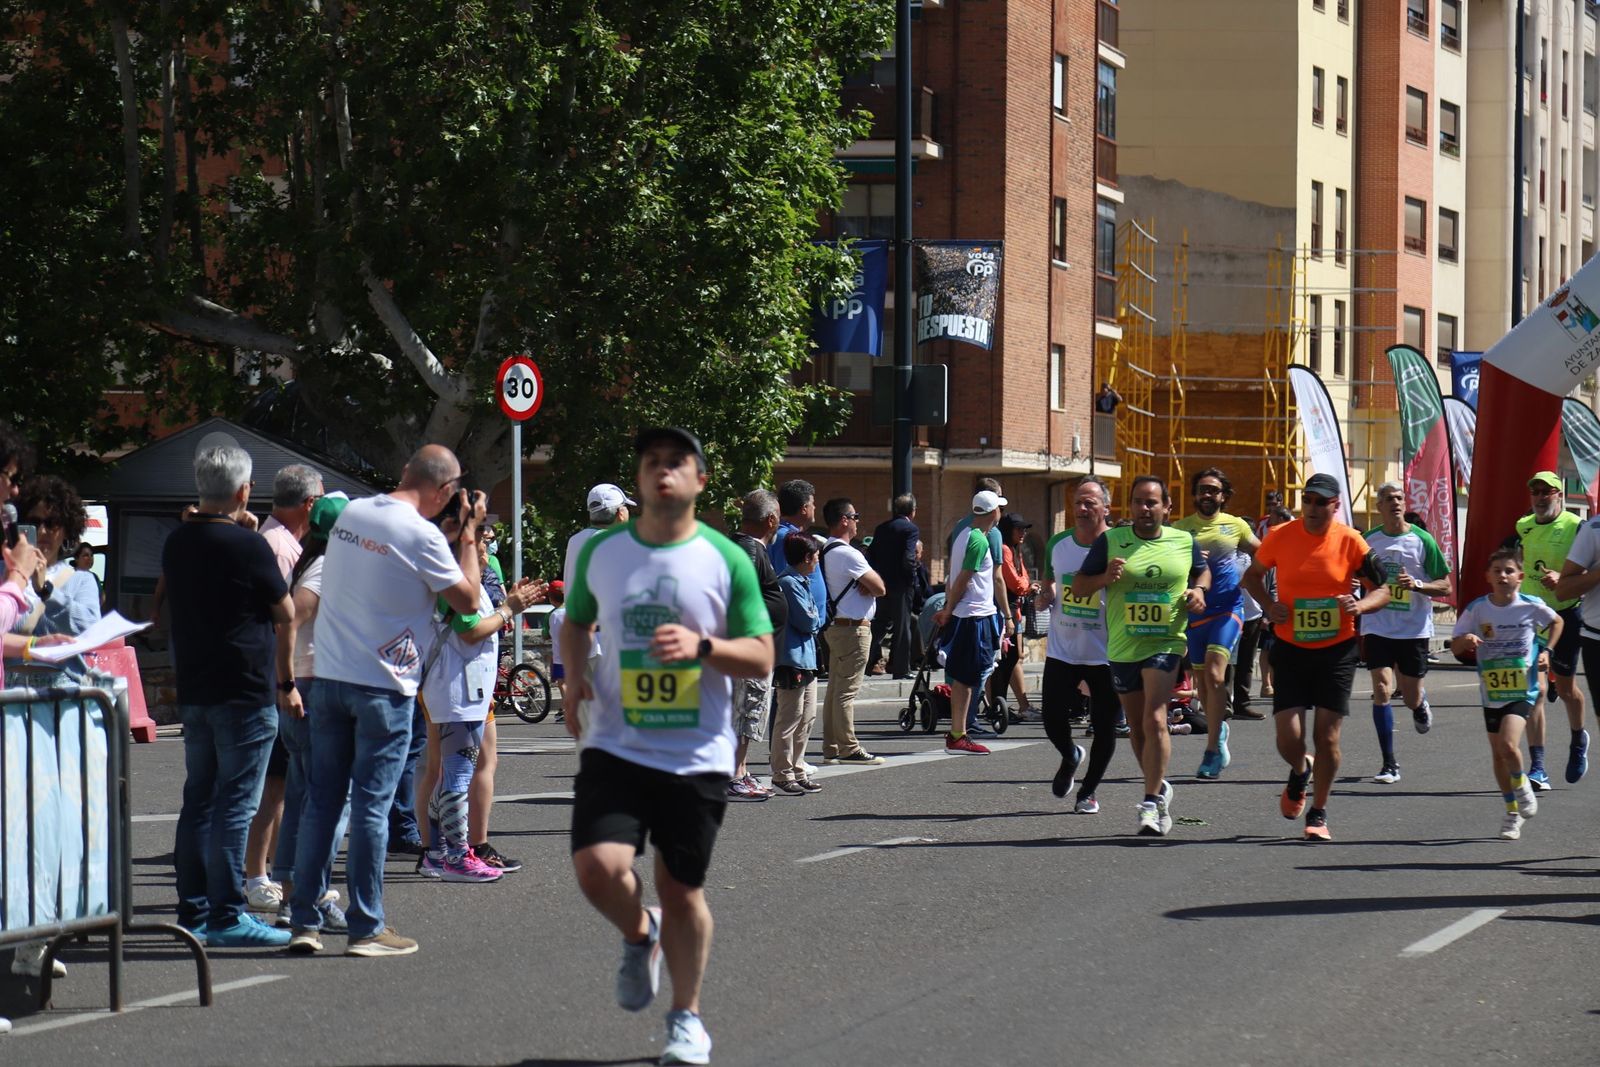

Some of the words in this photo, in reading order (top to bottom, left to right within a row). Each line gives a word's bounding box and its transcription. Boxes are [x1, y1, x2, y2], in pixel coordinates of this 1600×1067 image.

[968, 251, 994, 260] vota
[919, 294, 934, 318] TU
[917, 314, 989, 344] RESPUESTA
[1570, 359, 1588, 376] DE
[507, 377, 534, 399] 30
[1134, 581, 1168, 590] Adarsa
[1128, 604, 1162, 622] 130
[1297, 611, 1331, 628] 159
[636, 672, 677, 703] 99
[1488, 670, 1518, 689] 341
